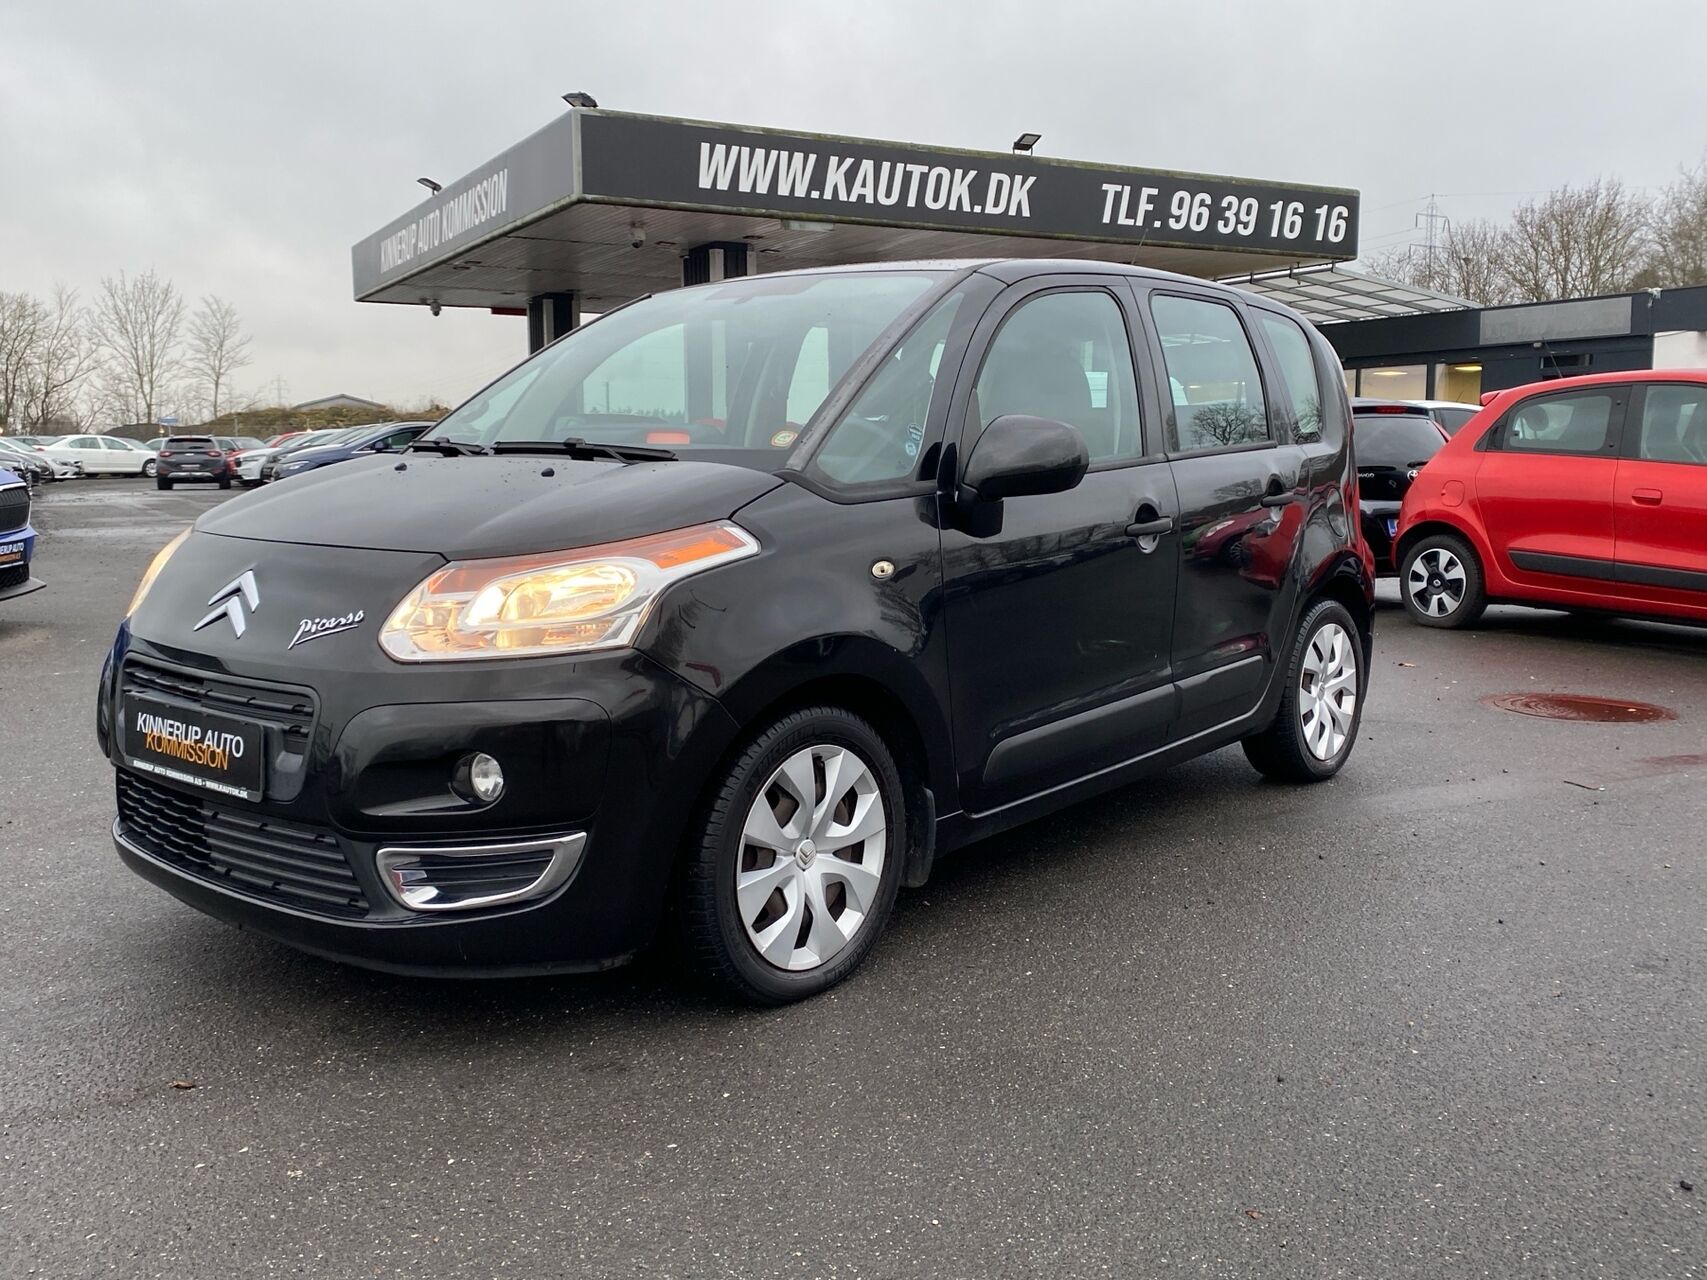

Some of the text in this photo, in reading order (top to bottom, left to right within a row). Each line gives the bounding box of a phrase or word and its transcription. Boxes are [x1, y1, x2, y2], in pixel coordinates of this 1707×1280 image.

[698, 142, 1037, 218] WWW.KAUTOK.DK
[381, 168, 508, 274] KINNERUP AUTO KOMMISSION
[1101, 183, 1349, 243] TLF. 96 39 16 16
[137, 712, 244, 758] KINNERUP AUTO
[146, 732, 229, 770] KOMMISSION
